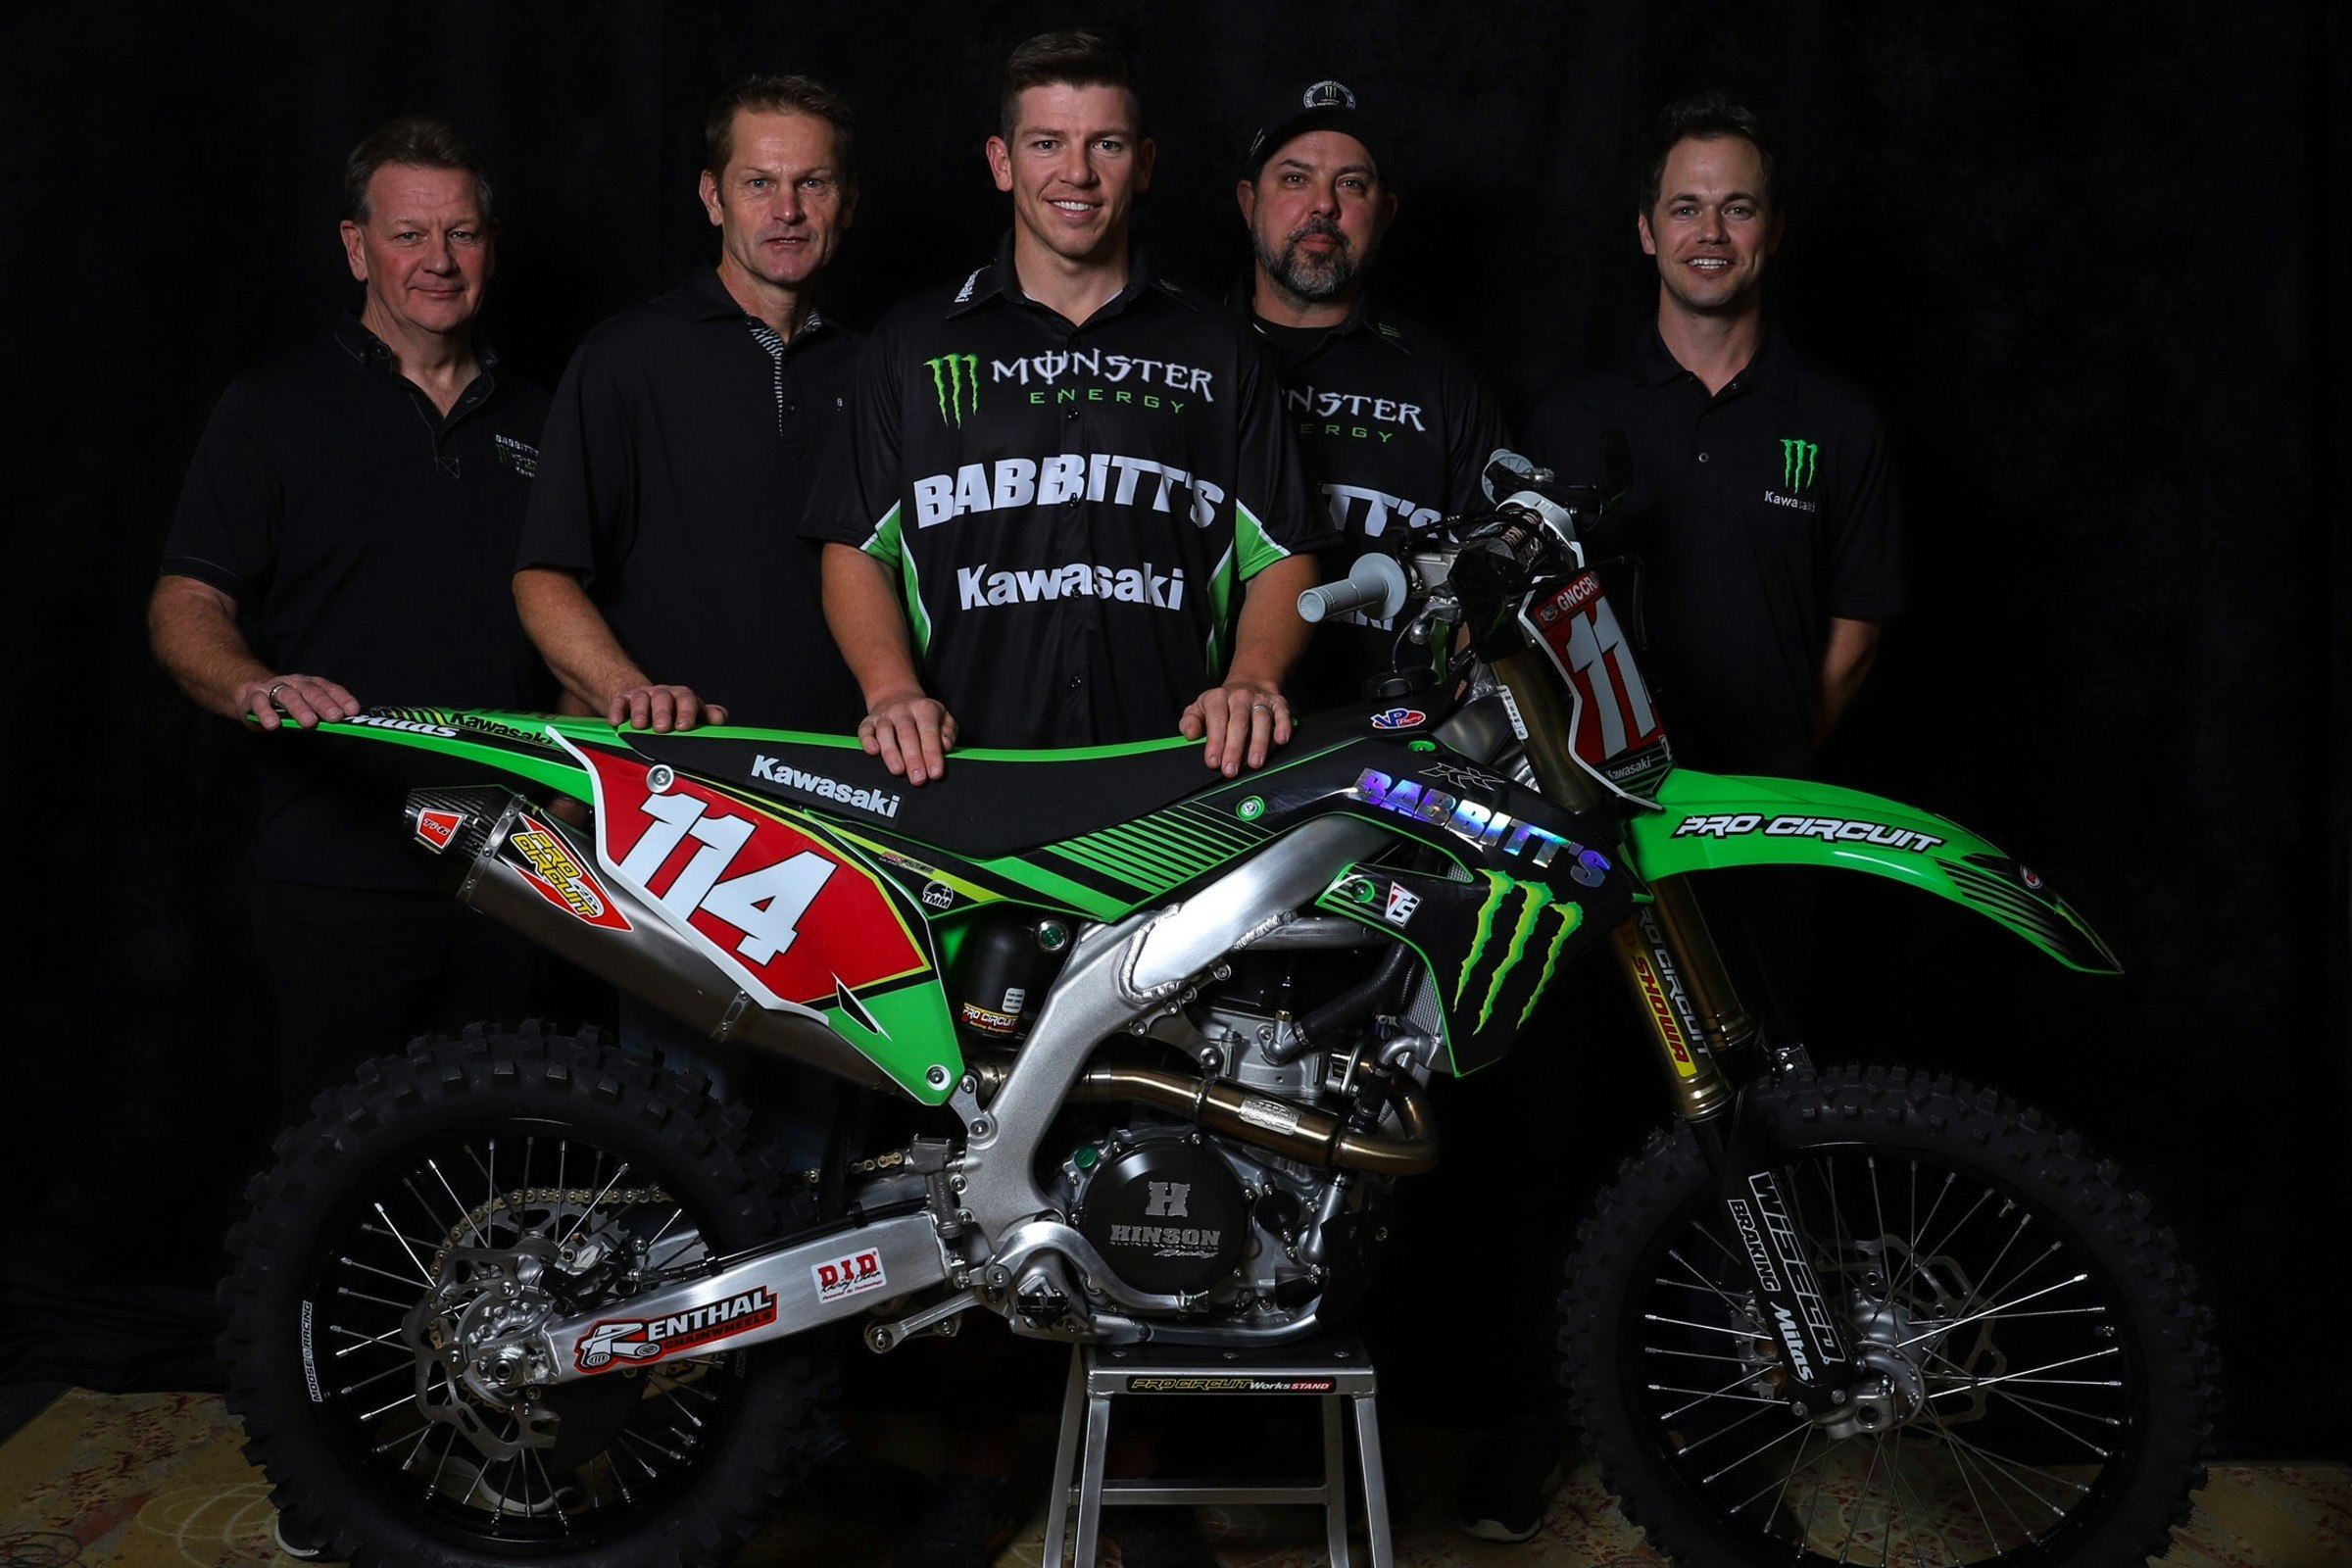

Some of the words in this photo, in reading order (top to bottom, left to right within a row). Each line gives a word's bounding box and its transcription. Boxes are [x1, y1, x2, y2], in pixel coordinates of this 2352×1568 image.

[1029, 387, 1186, 414] ENERGY
[1280, 384, 1426, 432] NSTER
[1298, 422, 1393, 443] ERGY
[912, 453, 1225, 529] BABBITT'S
[956, 561, 1185, 611] Kawasaki
[750, 754, 902, 819] Kawasaki
[1348, 767, 1612, 888] BABBITT'S
[1675, 814, 1763, 837] PRO
[1765, 815, 1944, 853] CIRCUIT
[513, 835, 598, 917] CIRCUIT
[529, 832, 581, 878] PRO
[619, 792, 839, 967] 114
[924, 892, 951, 907] TMM
[963, 1005, 981, 1019] PRO
[980, 1012, 1016, 1027] CIRCUIT
[1633, 956, 1690, 1063] SHOWA
[1654, 948, 1714, 1060] CIRCUIT
[1109, 1224, 1221, 1246] HINSON
[1727, 1199, 1782, 1293] BRAKING
[1748, 1170, 1845, 1365] WISECO
[302, 1299, 313, 1348] RACING
[1770, 1300, 1814, 1382] Mitas
[304, 1358, 322, 1402] MOOSE
[1131, 1378, 1178, 1391] PRO
[1175, 1378, 1252, 1391] CIRCUIT
[1249, 1382, 1292, 1391] Works
